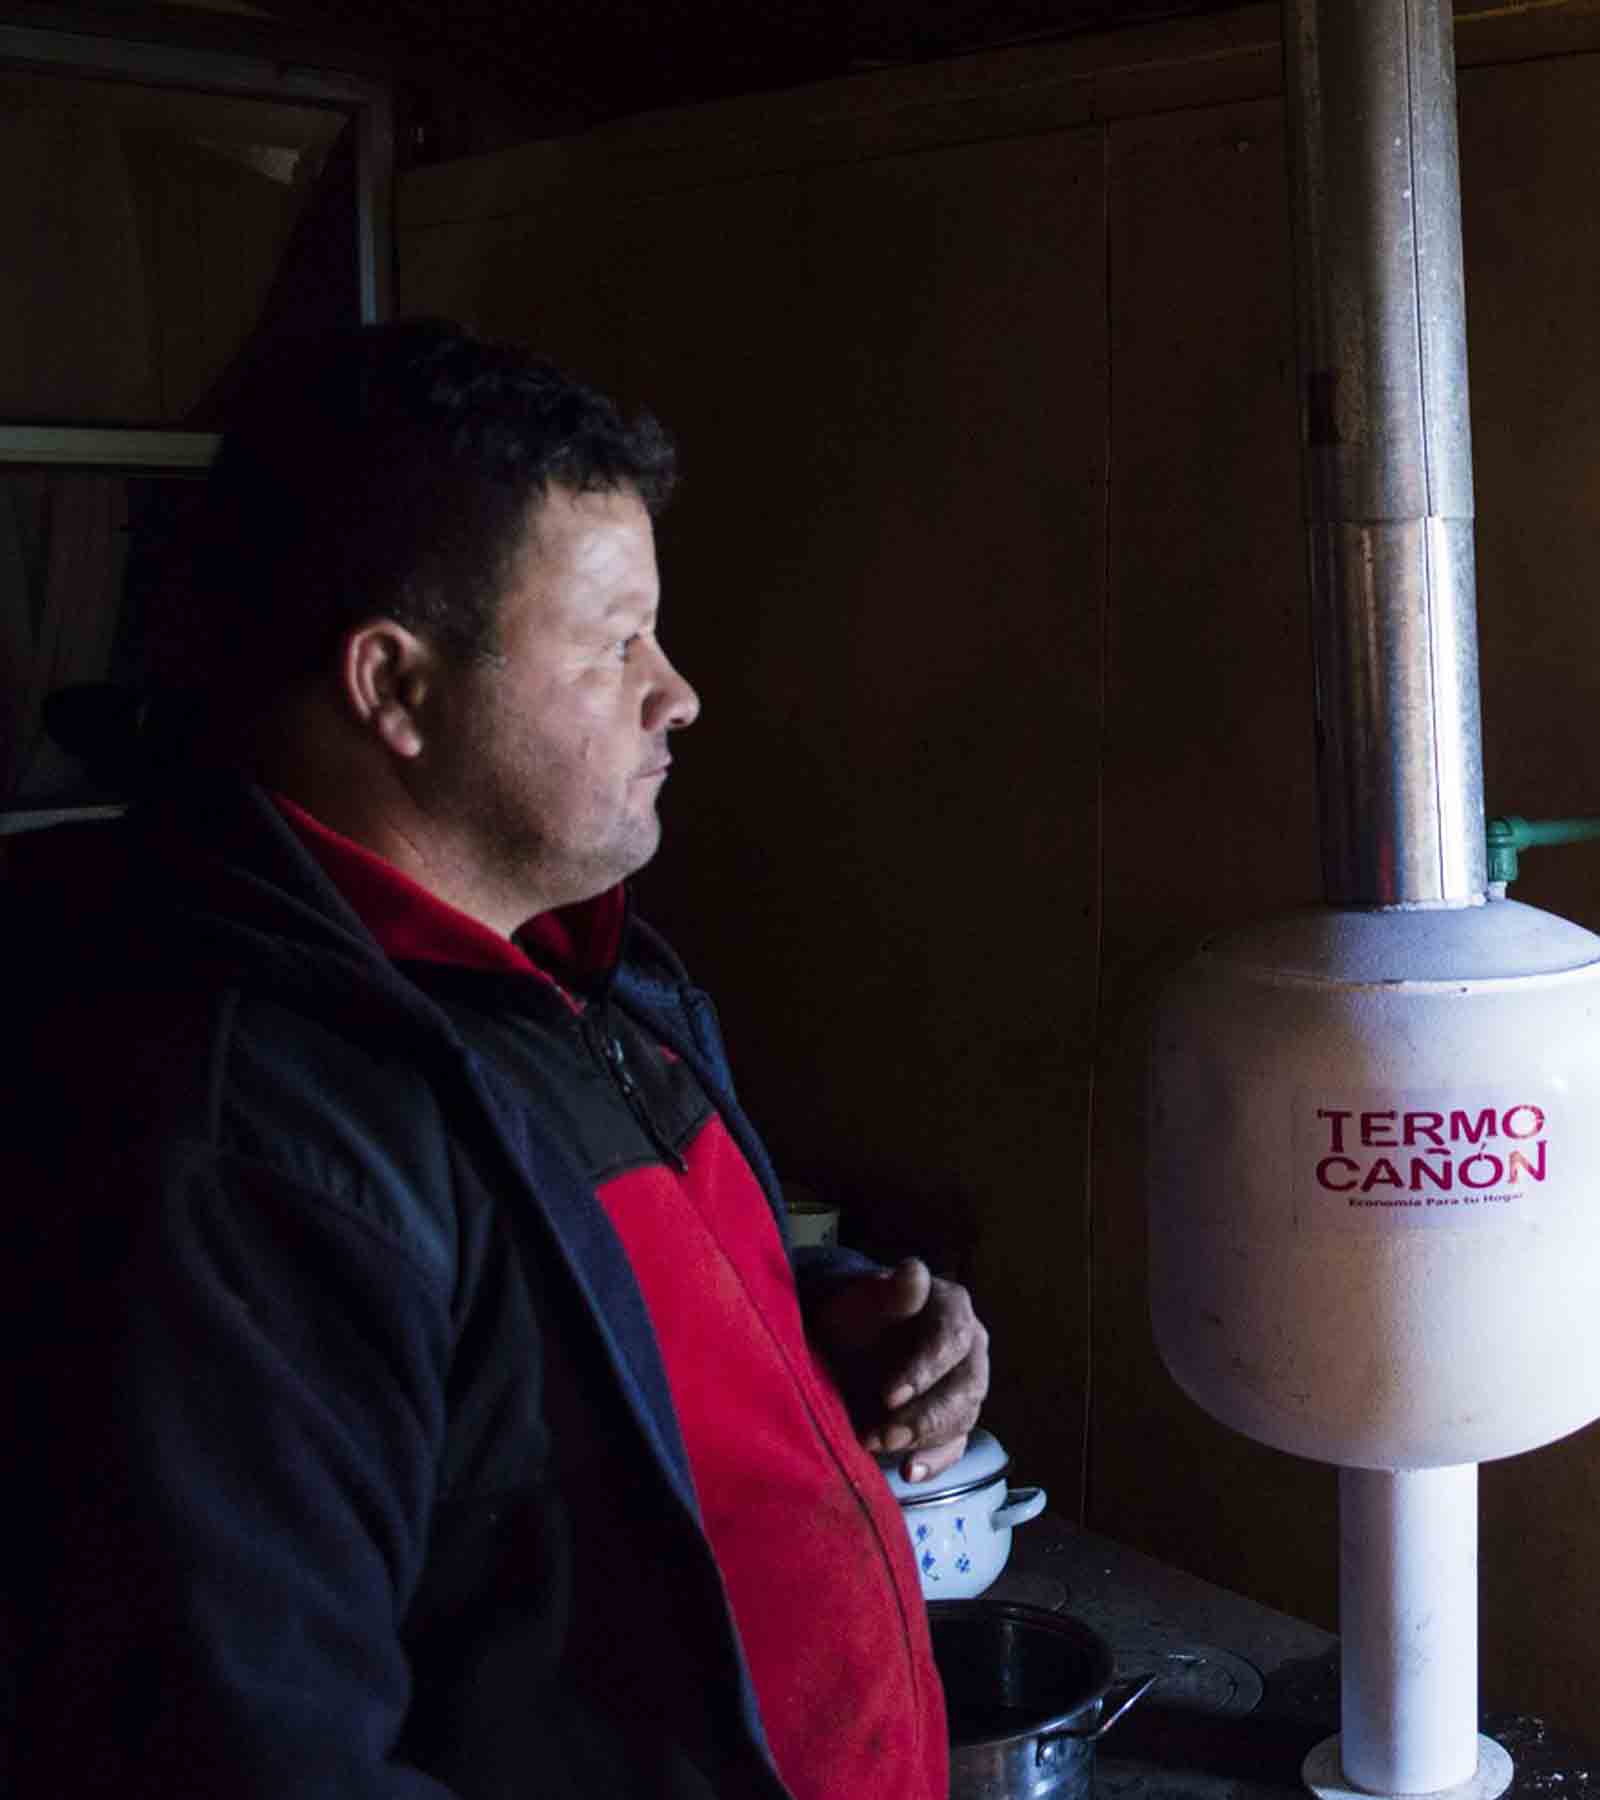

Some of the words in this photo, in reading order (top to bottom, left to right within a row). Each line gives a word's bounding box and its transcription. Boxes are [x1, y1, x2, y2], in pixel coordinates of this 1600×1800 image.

[1316, 1104, 1545, 1153] TERMO
[1315, 1140, 1548, 1192] CAÑÓN
[1426, 1195, 1459, 1206] Para
